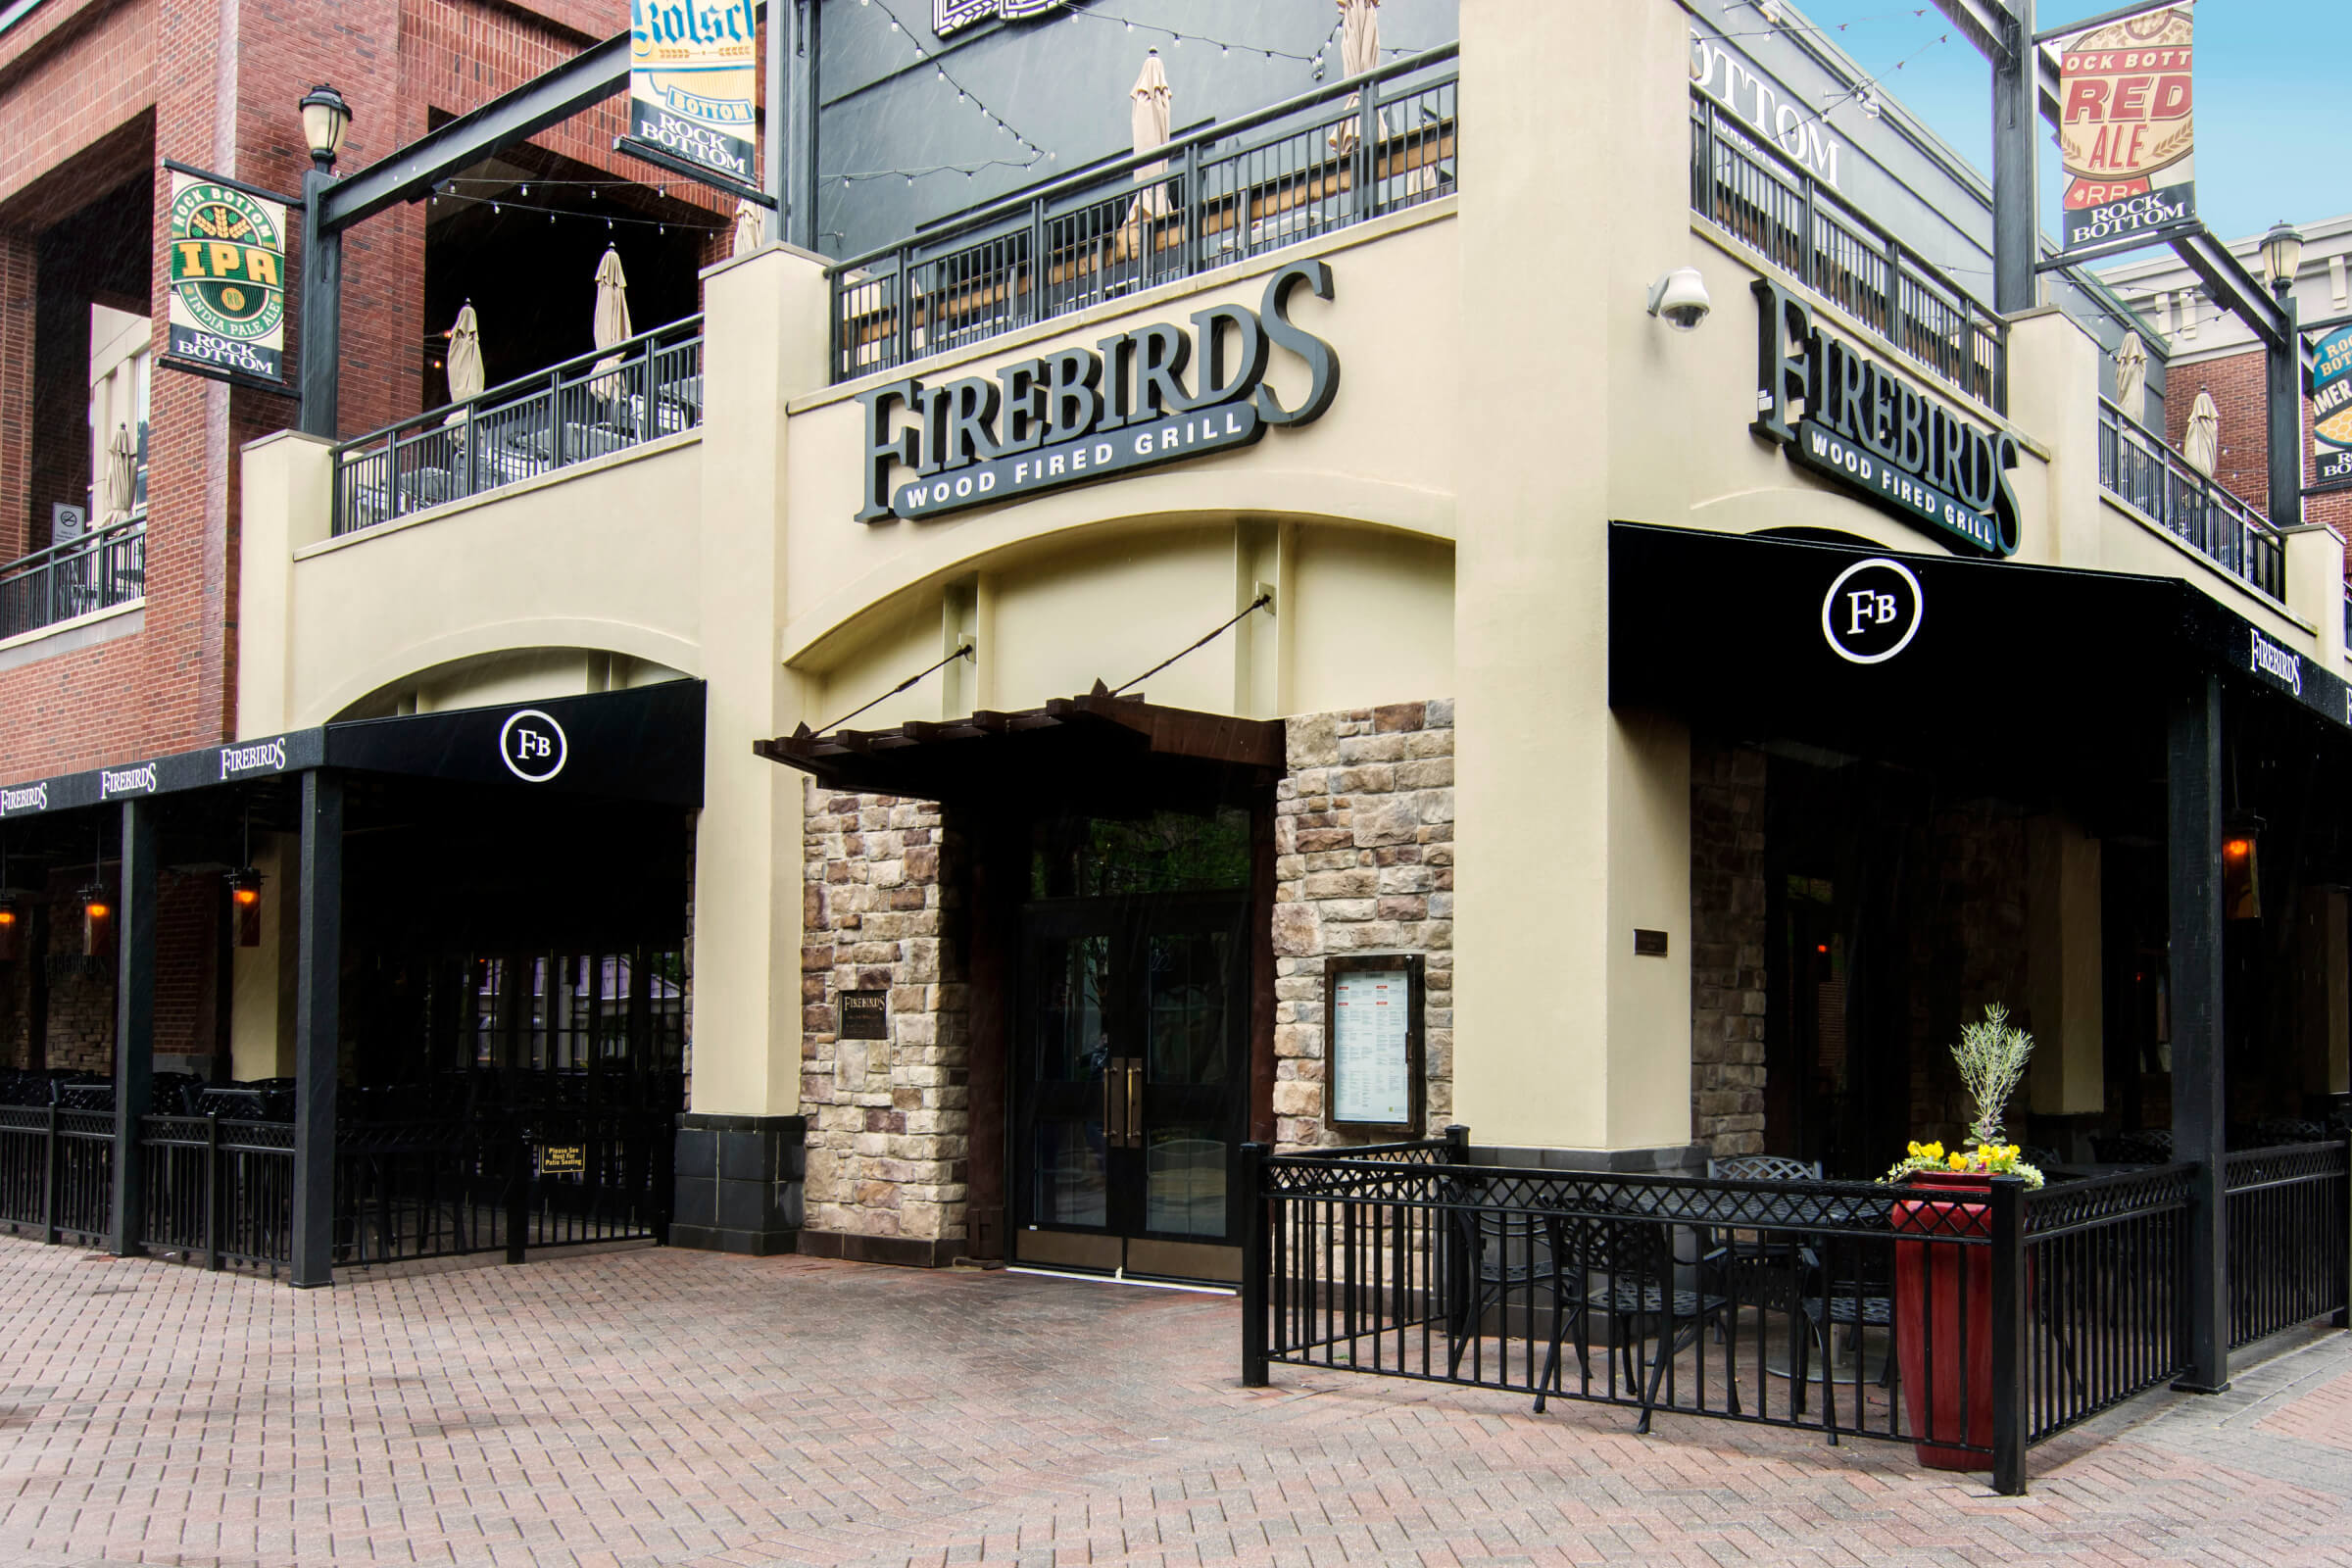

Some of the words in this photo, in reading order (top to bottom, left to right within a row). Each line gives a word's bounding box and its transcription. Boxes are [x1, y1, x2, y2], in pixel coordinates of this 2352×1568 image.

[672, 92, 749, 121] BOTTOM
[2063, 74, 2192, 123] RED
[641, 120, 747, 174] BOTTOM
[659, 113, 728, 152] ROCK
[2087, 123, 2149, 171] ALE
[173, 187, 205, 227] ROCK
[212, 187, 272, 237] BOTTOM
[2073, 202, 2185, 244] BOTTOM
[2090, 192, 2164, 224] ROCK
[178, 242, 278, 285] IPA
[188, 295, 224, 332] INDIA
[230, 319, 264, 336] PALE
[264, 300, 281, 326] ALE
[177, 339, 274, 375] BOTTOM
[195, 332, 257, 359] ROCK
[855, 259, 1341, 523] FIREBIRDS
[1749, 278, 2022, 557] FIREBIRDS
[906, 470, 997, 510] WOOD
[1015, 443, 1113, 484] FIRED
[1134, 412, 1242, 456] GRILL
[1811, 430, 1873, 480] WOOD
[1882, 470, 1936, 514] FIRED
[1944, 504, 1993, 546] GRILL
[1846, 589, 1897, 635] FB
[2250, 628, 2301, 696] FIREBIRDS
[220, 737, 286, 780] FIREBIRDS
[516, 729, 551, 760] FB
[0, 783, 47, 816] FIREBIRDS
[101, 762, 157, 801] FIREBIRDS
